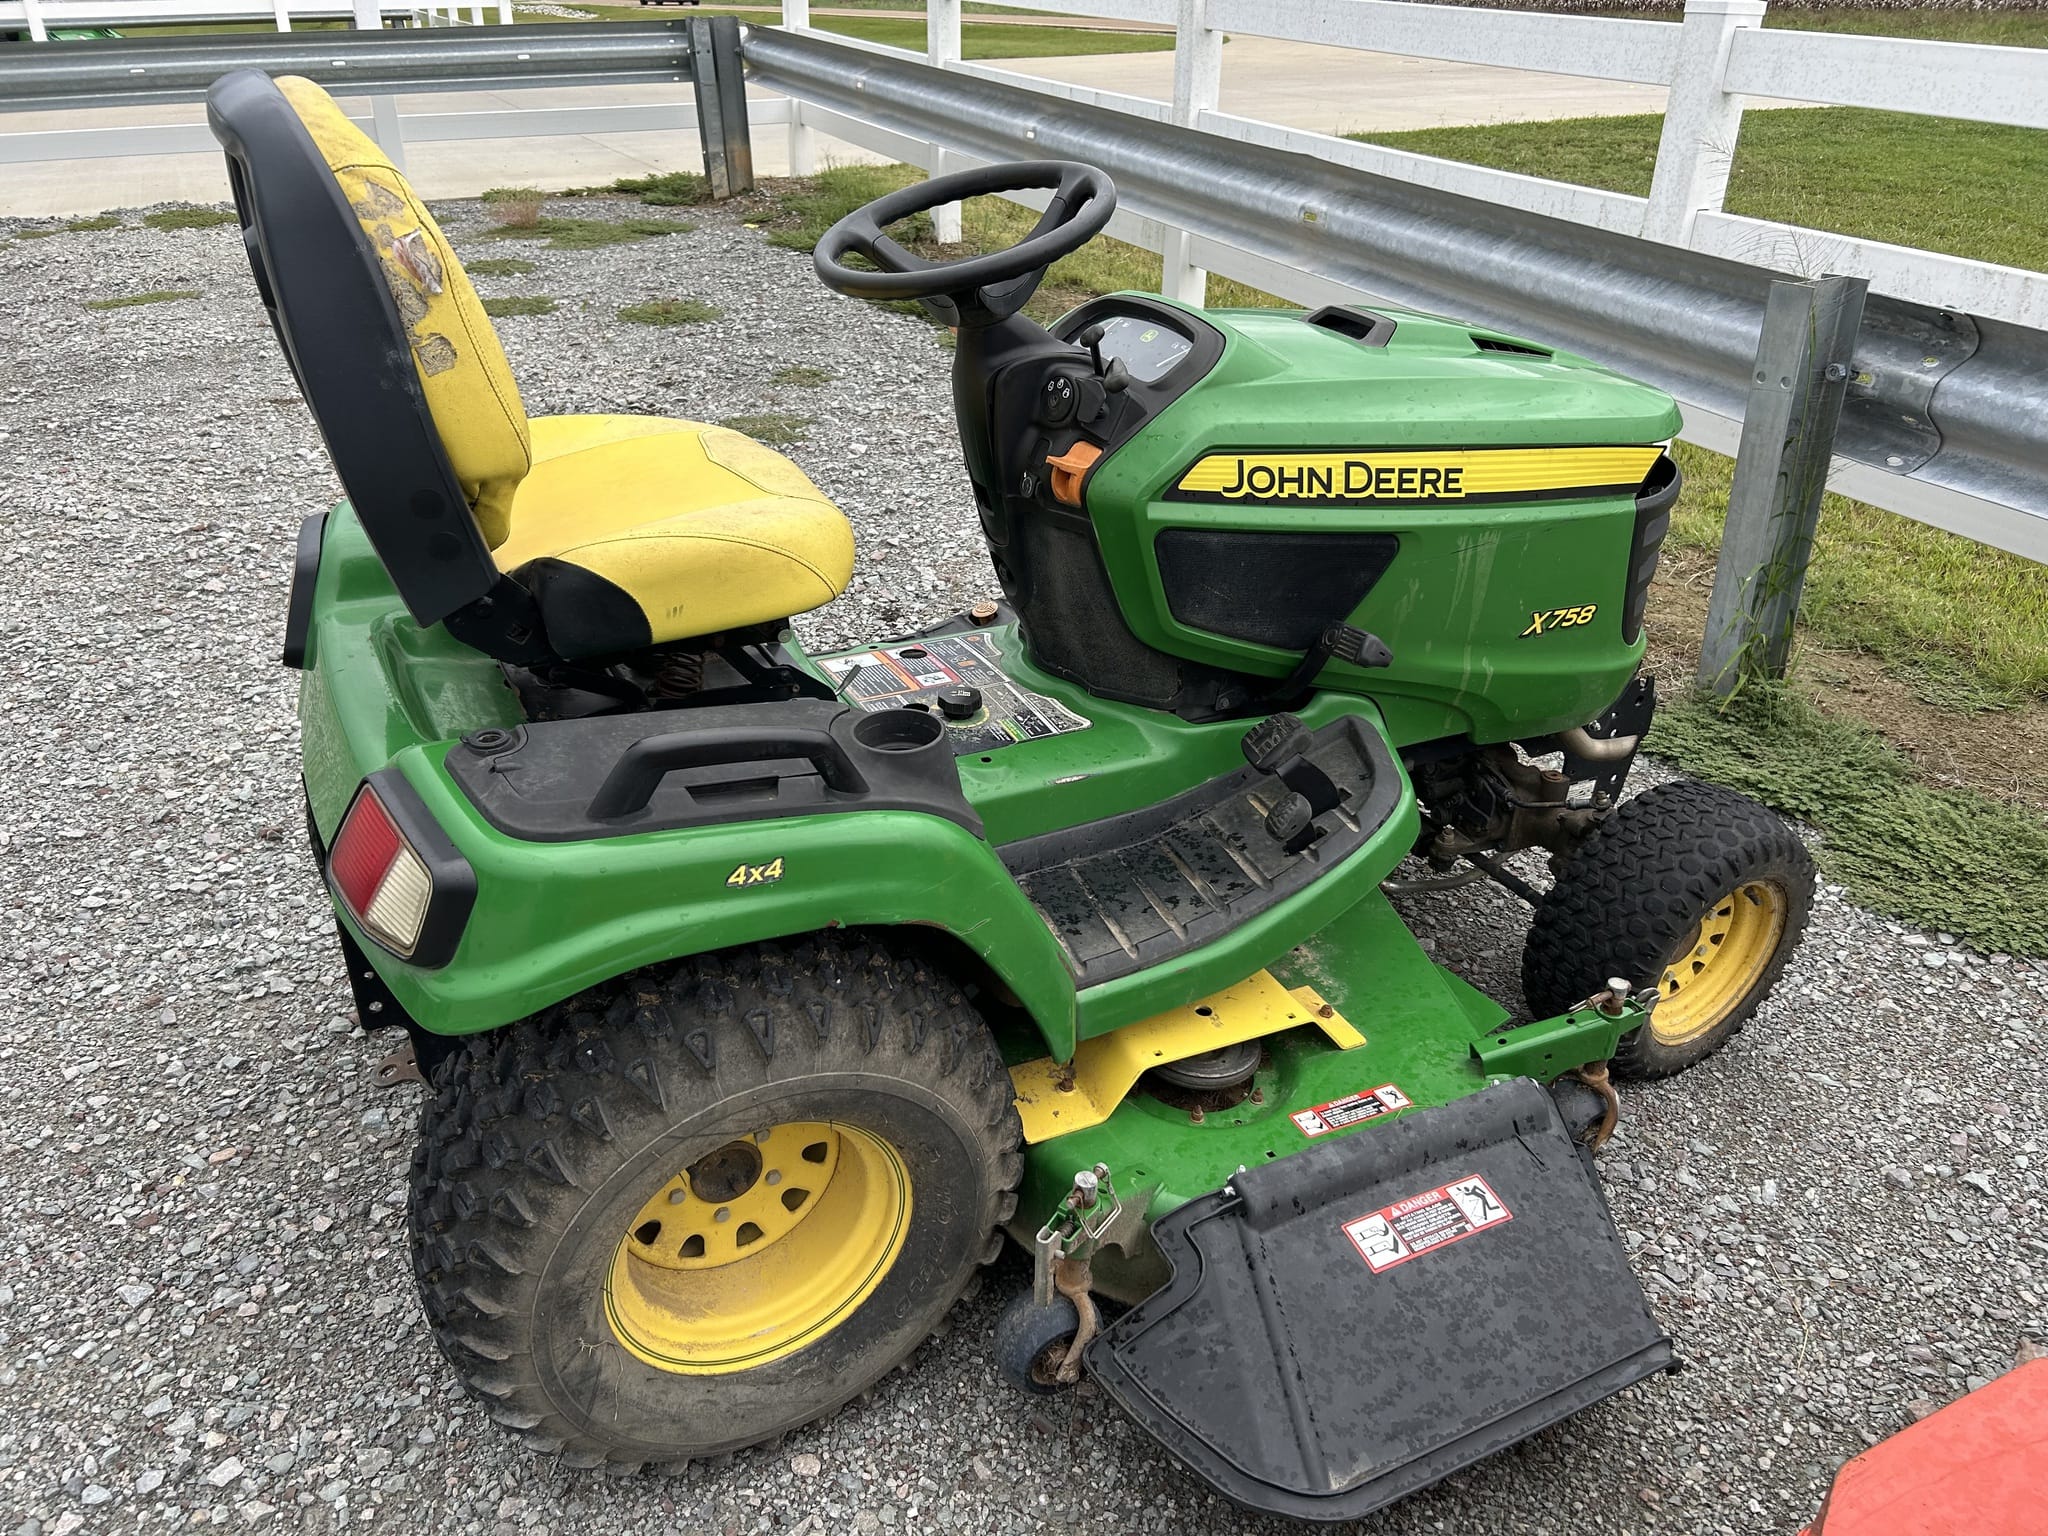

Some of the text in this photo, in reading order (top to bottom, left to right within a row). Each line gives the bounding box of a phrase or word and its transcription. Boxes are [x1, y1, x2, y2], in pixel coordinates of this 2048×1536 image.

[1222, 459, 1464, 494] JOHN DEERE
[1520, 604, 1597, 636] X758
[727, 858, 783, 885] 4x4
[1399, 1191, 1441, 1213] DANGER
